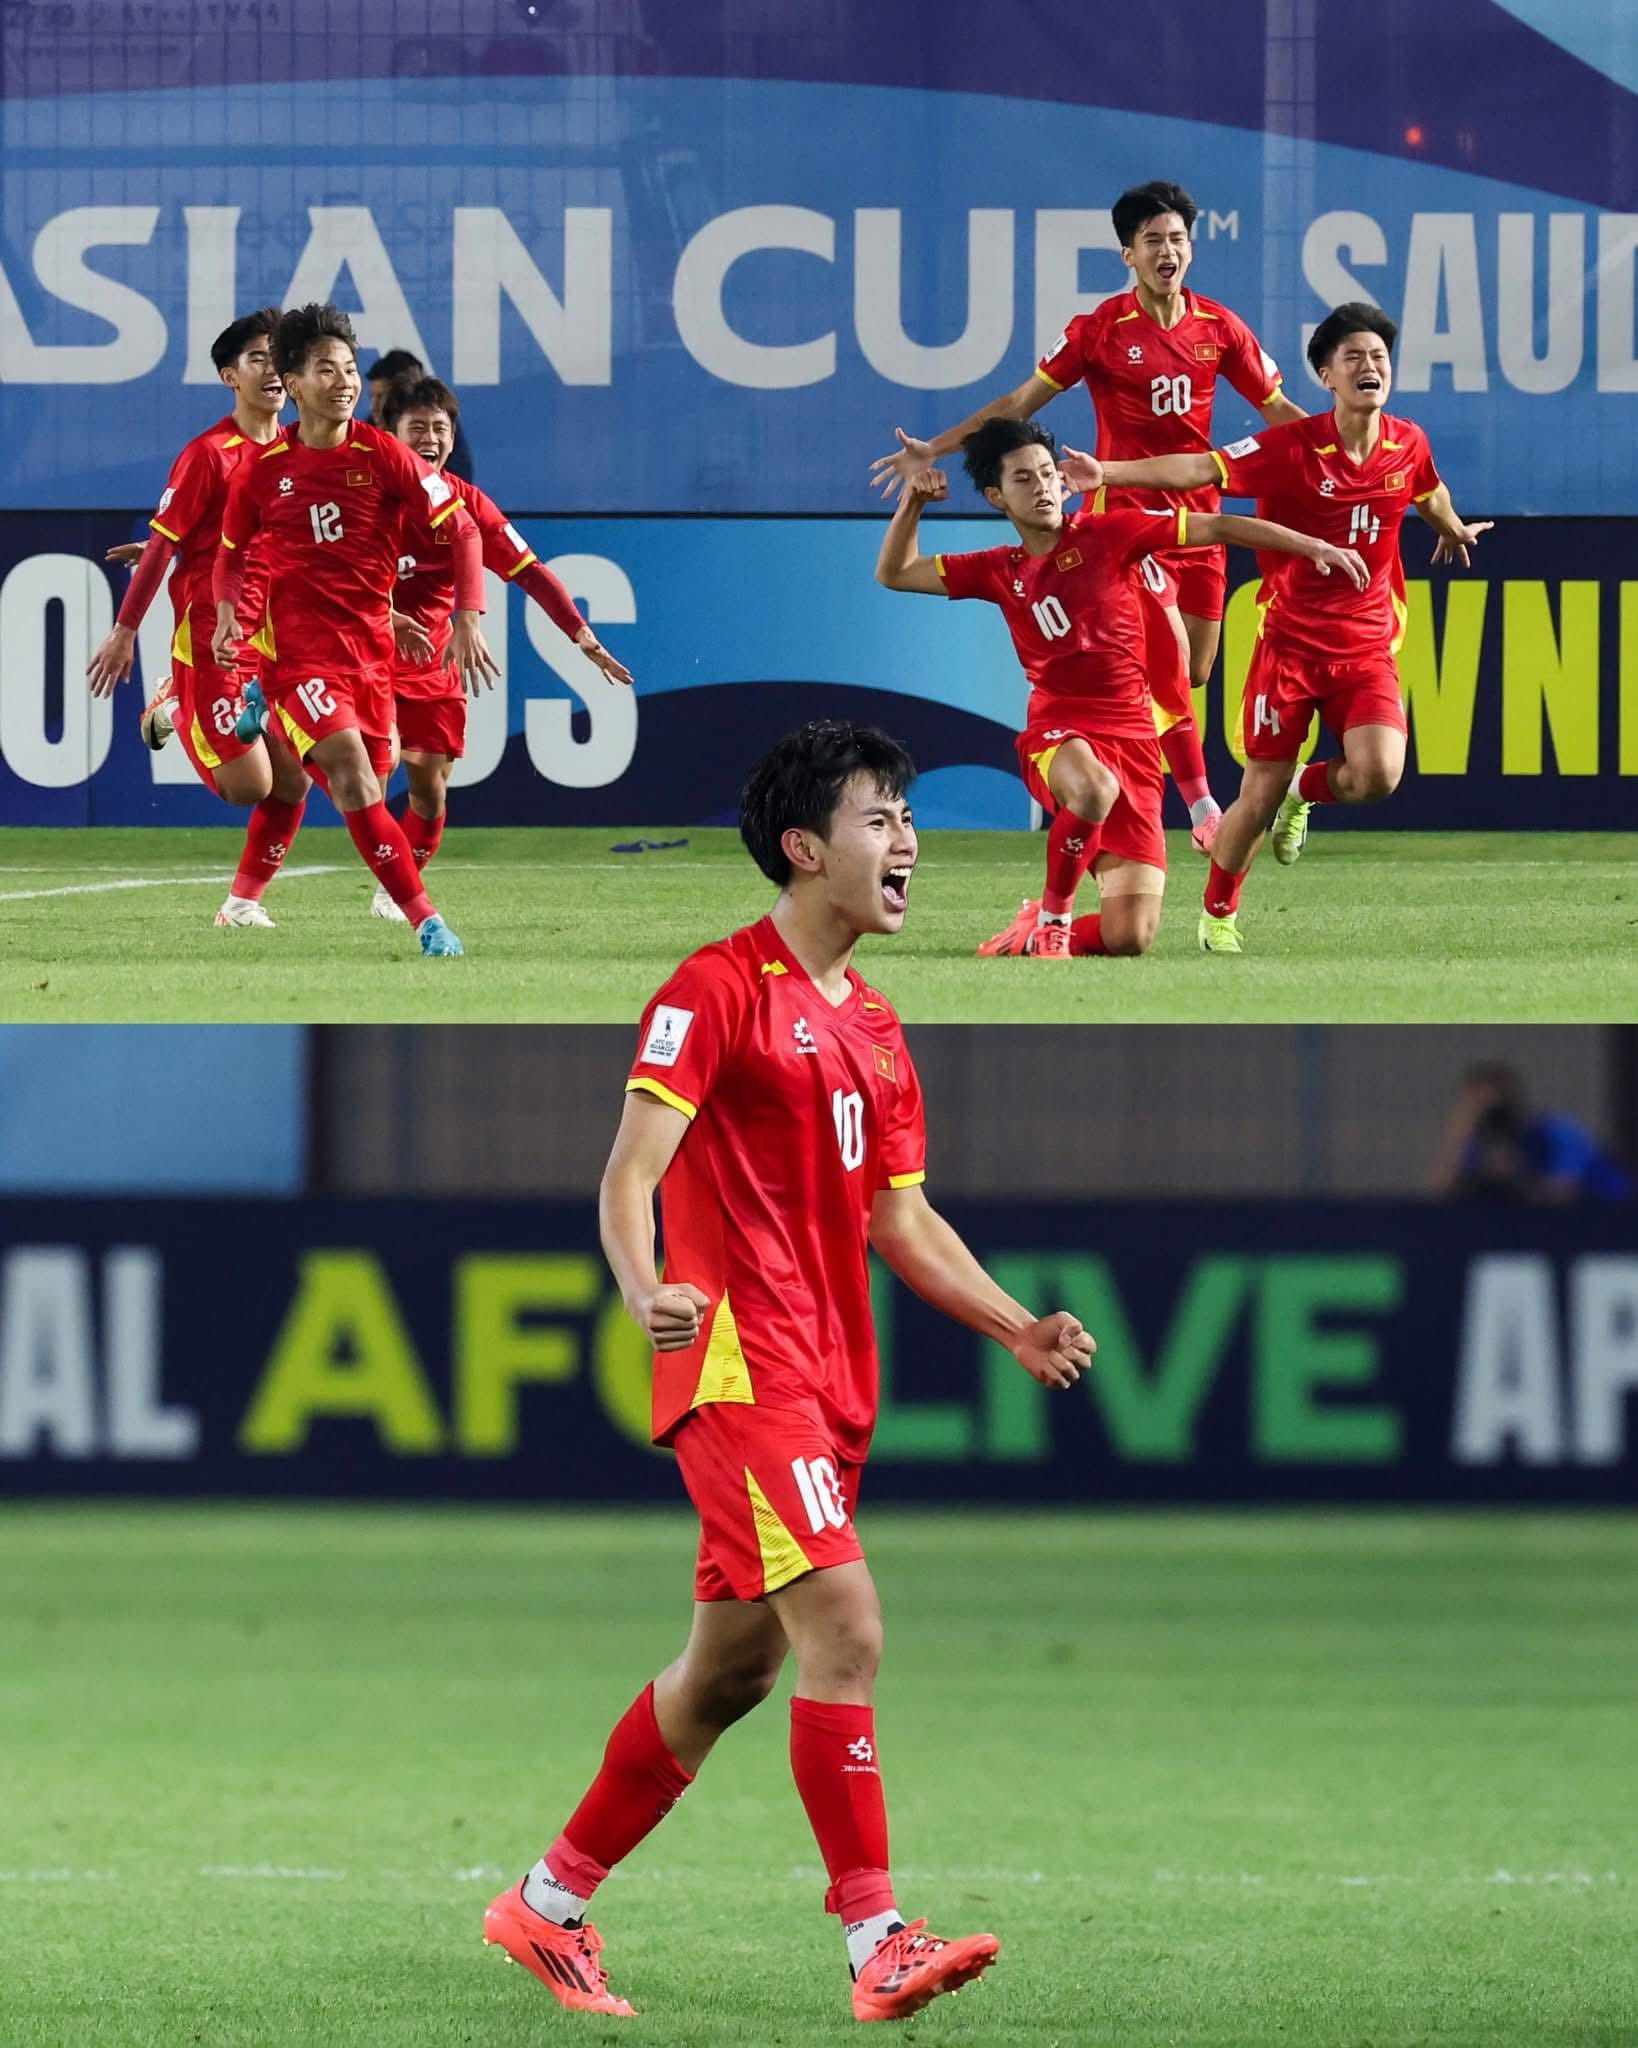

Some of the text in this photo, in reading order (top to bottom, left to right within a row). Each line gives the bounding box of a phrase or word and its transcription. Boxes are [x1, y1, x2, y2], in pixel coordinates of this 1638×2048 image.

[0, 205, 612, 387] SIAN
[1151, 373, 1192, 417] 20
[309, 501, 344, 544] 12
[1348, 503, 1381, 545] 14
[1031, 594, 1072, 641] 10
[295, 677, 337, 724] 12
[1252, 693, 1281, 737] 14
[832, 1087, 865, 1173] 10
[0, 1245, 197, 1460] AL
[867, 1253, 1406, 1465] LIVE
[790, 1456, 849, 1536] 10
